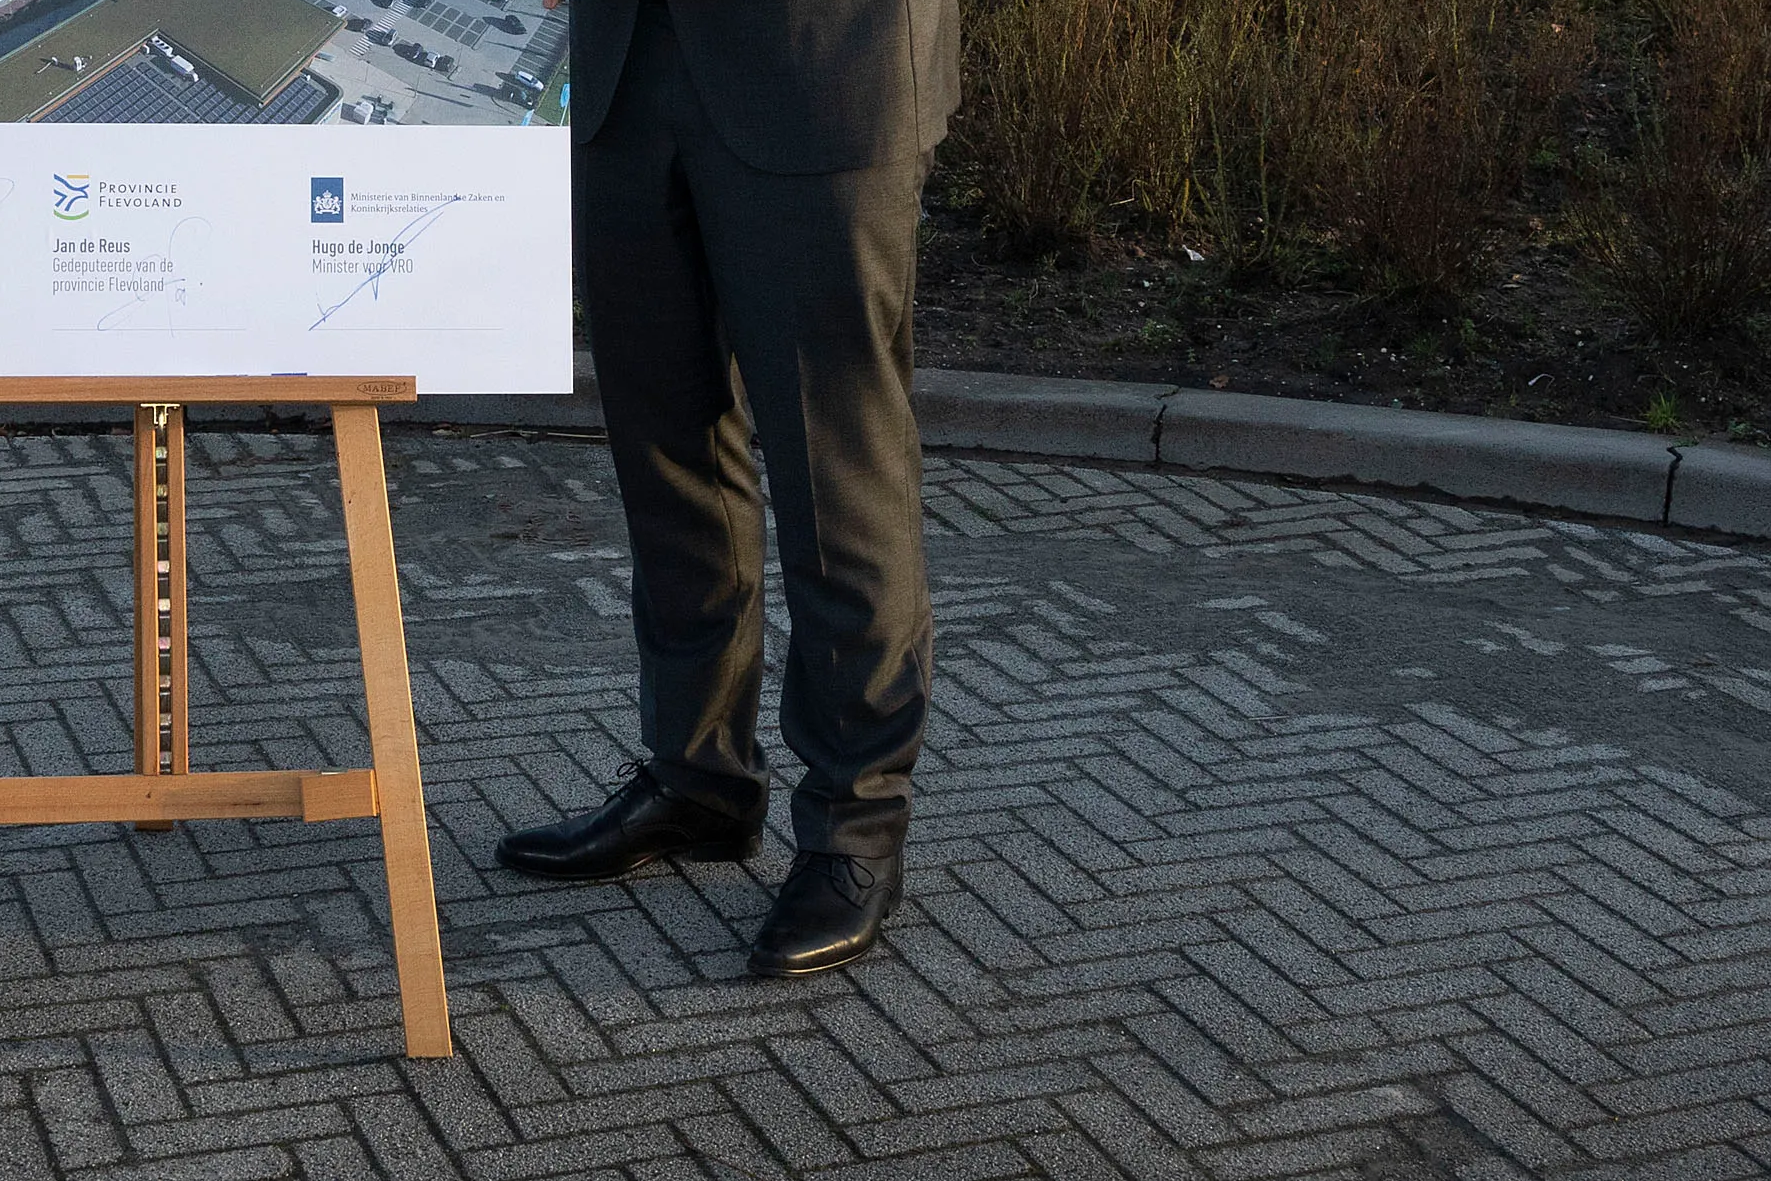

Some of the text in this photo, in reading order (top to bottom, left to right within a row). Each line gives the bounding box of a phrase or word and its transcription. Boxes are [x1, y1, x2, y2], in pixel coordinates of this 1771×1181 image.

[99, 181, 177, 194] PROVINCIE
[99, 195, 182, 208] FLEVOLAND
[350, 192, 393, 202] Ministerie
[468, 192, 493, 202] Zaken
[350, 204, 428, 215] Koninkrijksrelaties
[52, 238, 131, 253] Jan de Reus
[312, 239, 404, 258] Hugo de Jonge
[52, 257, 174, 276] Gedeputeerde van de
[311, 258, 414, 275] Minister voor VRO
[52, 276, 165, 296] provincie Flevoland
